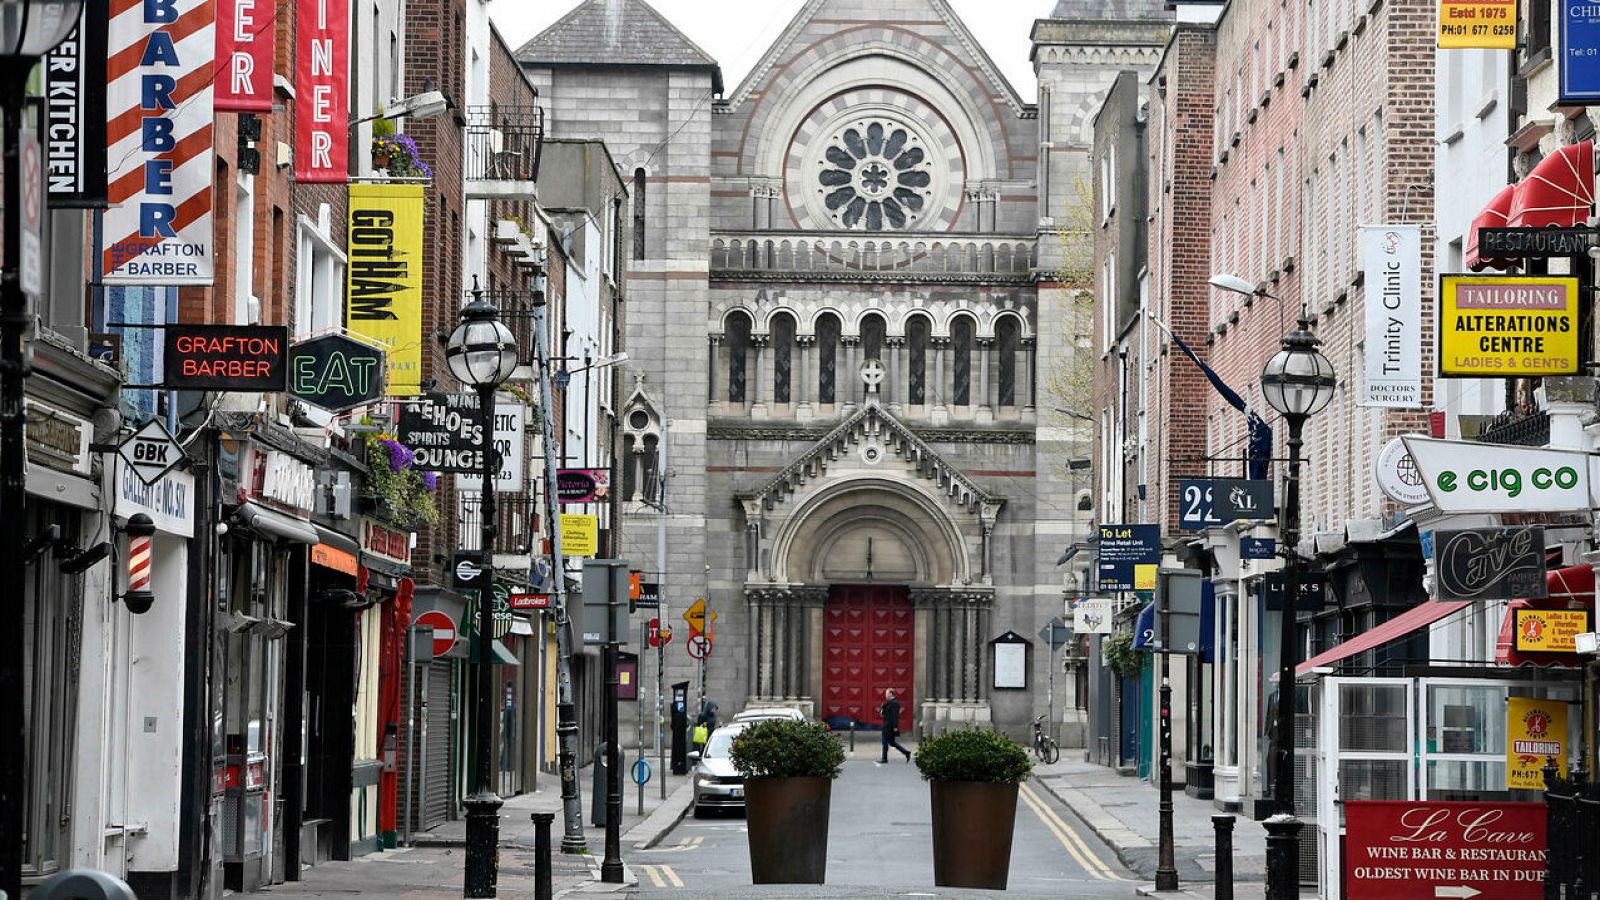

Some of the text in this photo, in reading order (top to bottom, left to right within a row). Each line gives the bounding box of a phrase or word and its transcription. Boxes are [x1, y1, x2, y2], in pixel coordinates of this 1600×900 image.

[1449, 8, 1507, 18] Estd 1975
[1570, 6, 1600, 17] CHI
[1441, 25, 1515, 36] PH:01 677 6258
[1569, 48, 1597, 56] Tel: 01
[48, 80, 76, 193] KITCHEN
[1485, 231, 1587, 253] RESTAURANT
[126, 243, 205, 257] GRAFTON
[128, 262, 198, 276] BARBER
[351, 210, 411, 320] GOTHAM
[1464, 289, 1559, 305] TAILORING
[1382, 261, 1404, 375] Trinity Clinic
[1455, 316, 1570, 332] ALTERATIONS
[176, 336, 278, 356] GRAFTON
[1479, 336, 1544, 353] CENTRE
[183, 360, 270, 377] BARBER
[1455, 357, 1569, 369] LADIES & GENTS
[293, 351, 377, 396] EAT
[447, 395, 481, 409] WINE
[1370, 394, 1414, 402] SURGERY
[407, 431, 450, 446] SPIRITS
[134, 444, 170, 463] GBK
[412, 448, 484, 469] OUNGE
[1437, 466, 1579, 498] e cig co
[1101, 529, 1132, 538] To Let
[1271, 583, 1319, 592] LIKS
[1515, 742, 1560, 754] TAILORING
[1390, 807, 1535, 843] La Cave
[1367, 847, 1408, 859] WINE
[1411, 848, 1442, 859] BAR
[1445, 848, 1455, 860] &
[1354, 867, 1411, 880] OLDEST
[1415, 868, 1455, 880] WINE
[1459, 869, 1490, 881] BAR
[1493, 869, 1510, 881] IN
